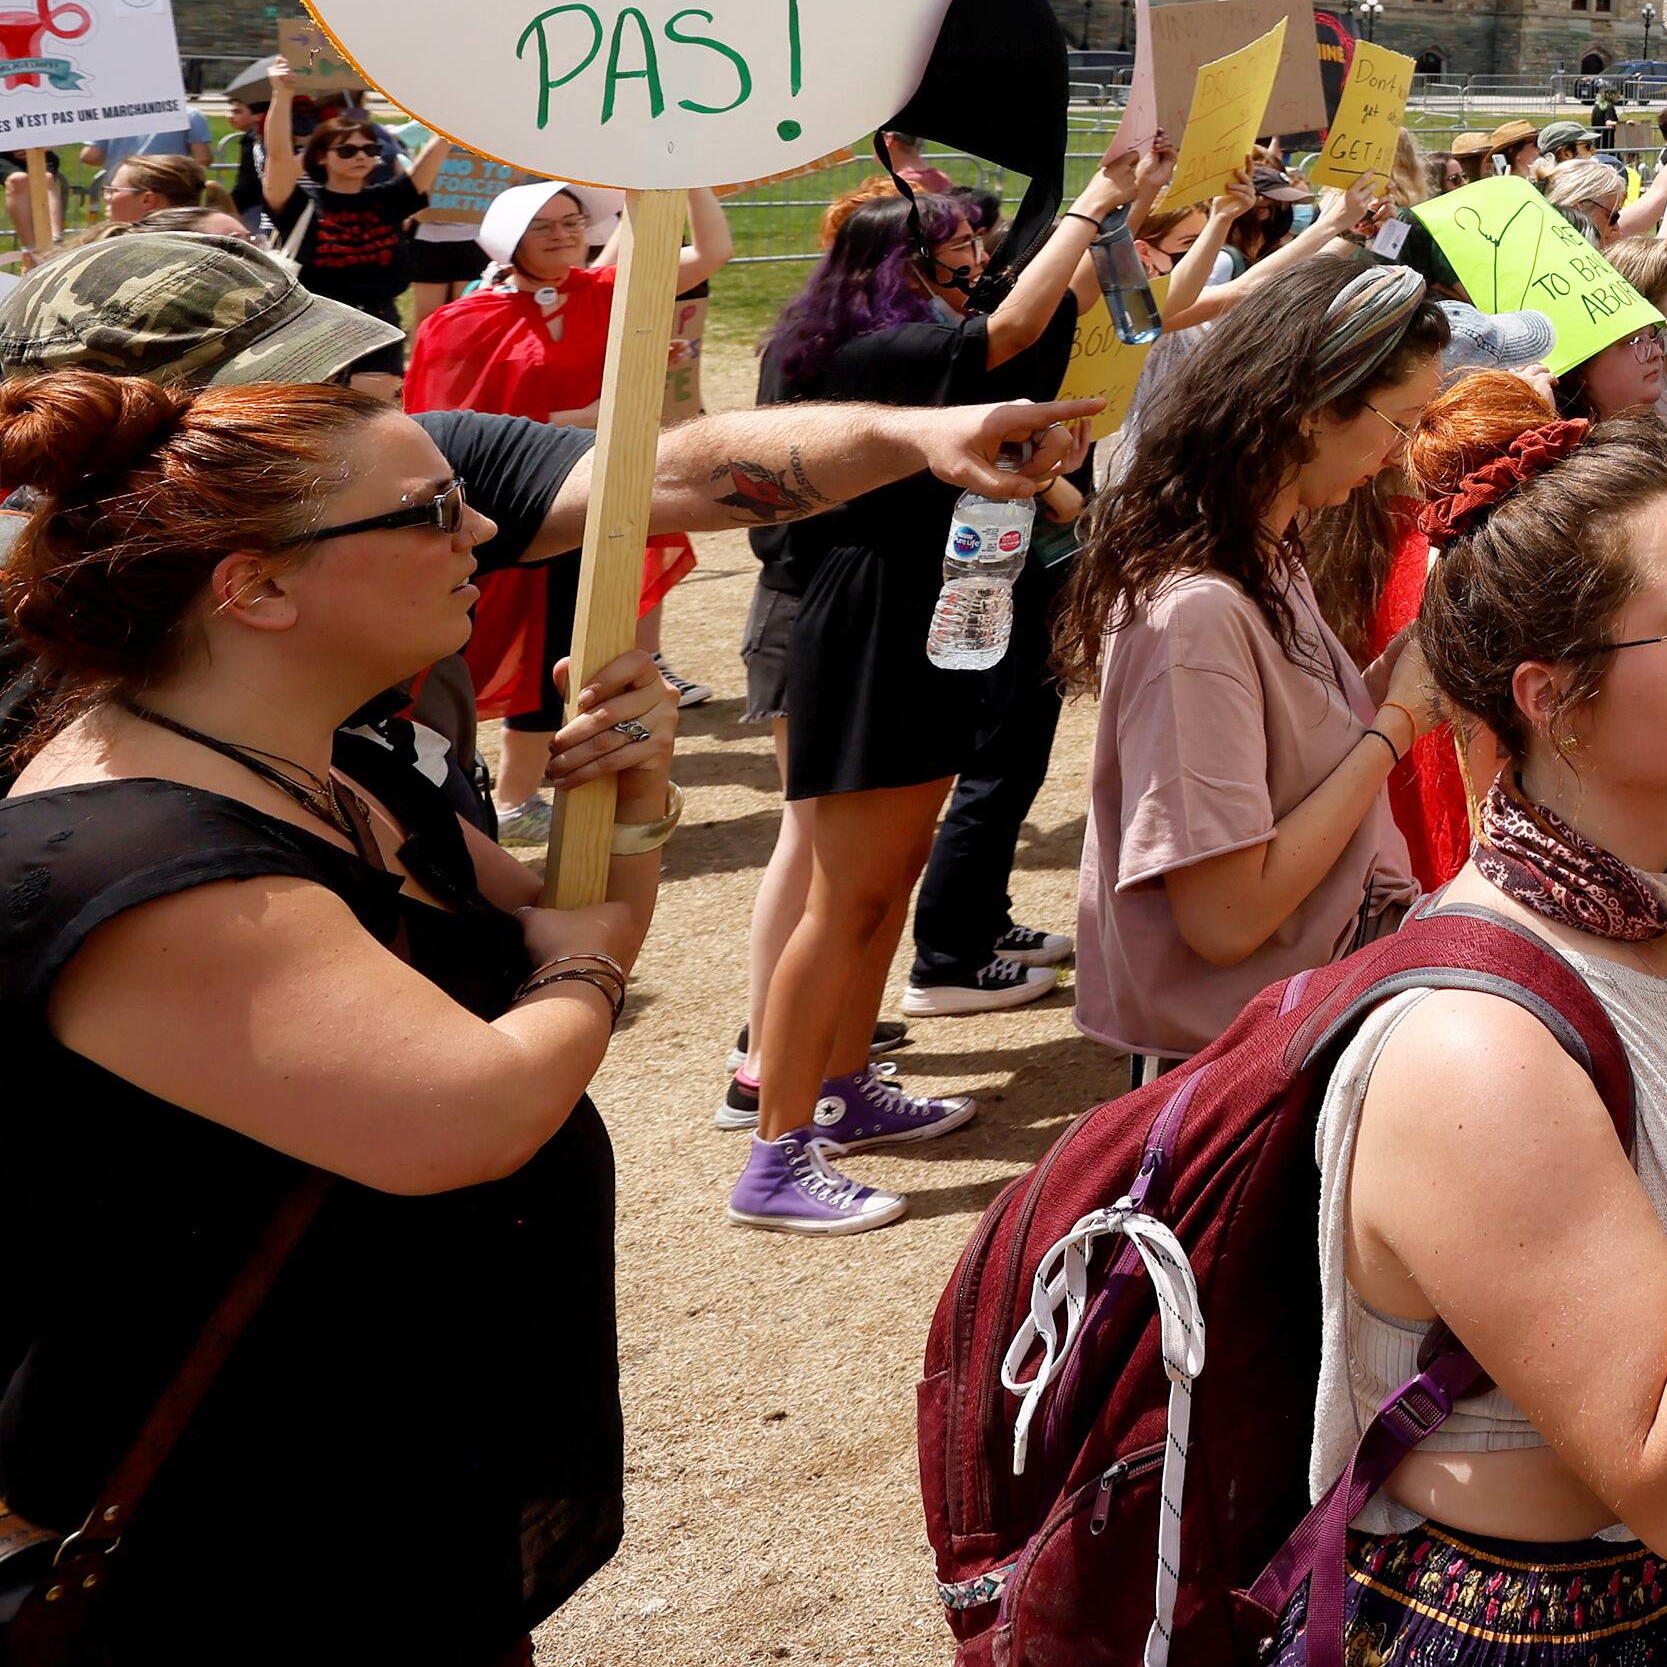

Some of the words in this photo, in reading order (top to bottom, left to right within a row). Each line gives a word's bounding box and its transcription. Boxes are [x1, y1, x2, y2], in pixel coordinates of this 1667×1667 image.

[1355, 59, 1397, 93] Don't
[16, 113, 48, 129] N'EST
[52, 110, 74, 124] PAS
[78, 108, 99, 122] UNE
[101, 99, 180, 119] MARCHANDISE
[1329, 134, 1372, 161] GET
[442, 159, 473, 176] NO
[482, 161, 513, 179] TO
[1532, 273, 1570, 301] TO
